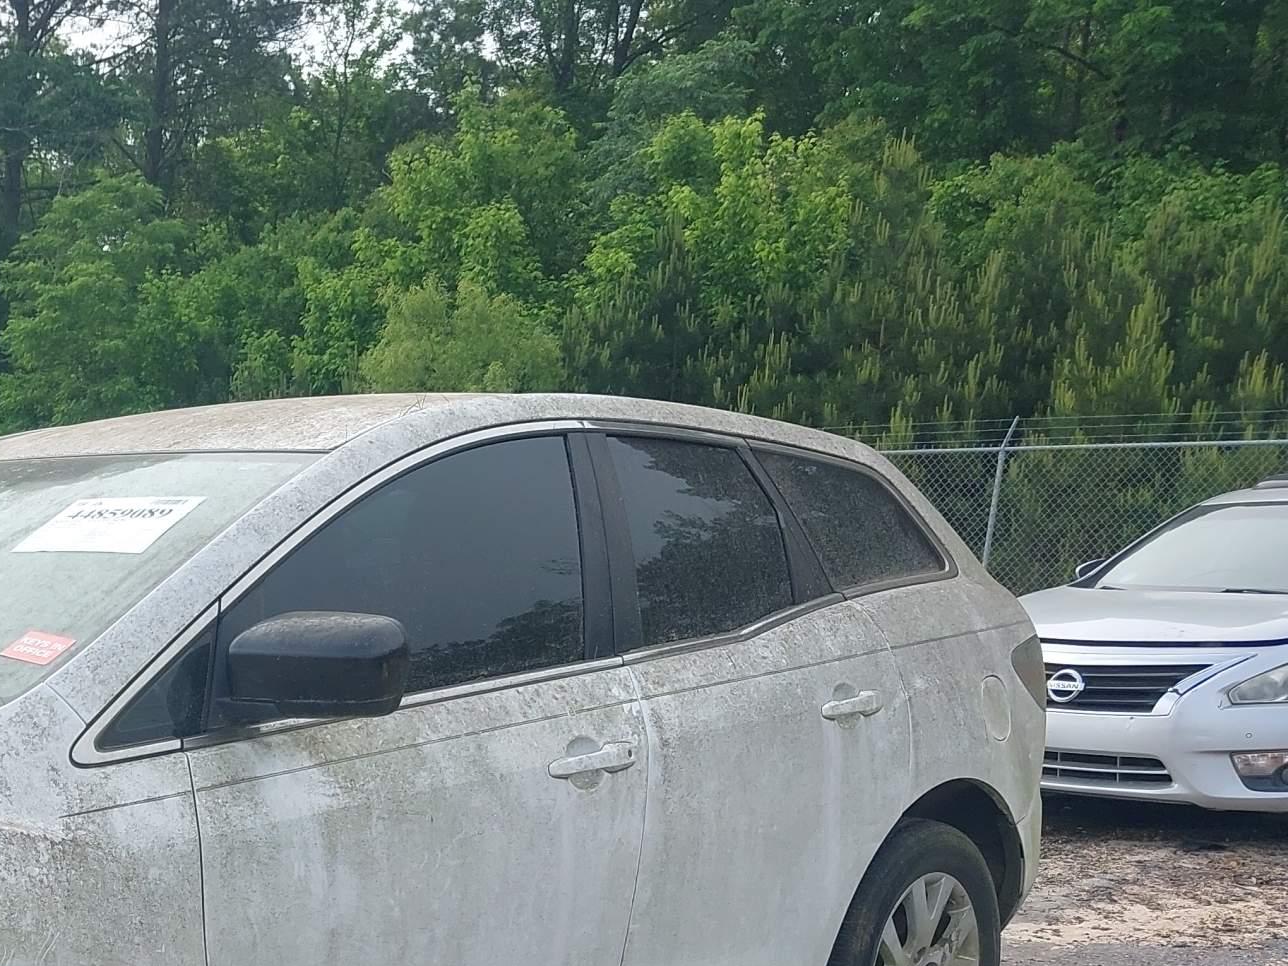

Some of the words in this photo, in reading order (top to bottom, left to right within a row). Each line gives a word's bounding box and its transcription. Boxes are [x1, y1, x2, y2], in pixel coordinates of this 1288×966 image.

[65, 508, 174, 520] 44859089
[20, 637, 51, 649] KEYS
[1048, 681, 1080, 690] NISSAN
